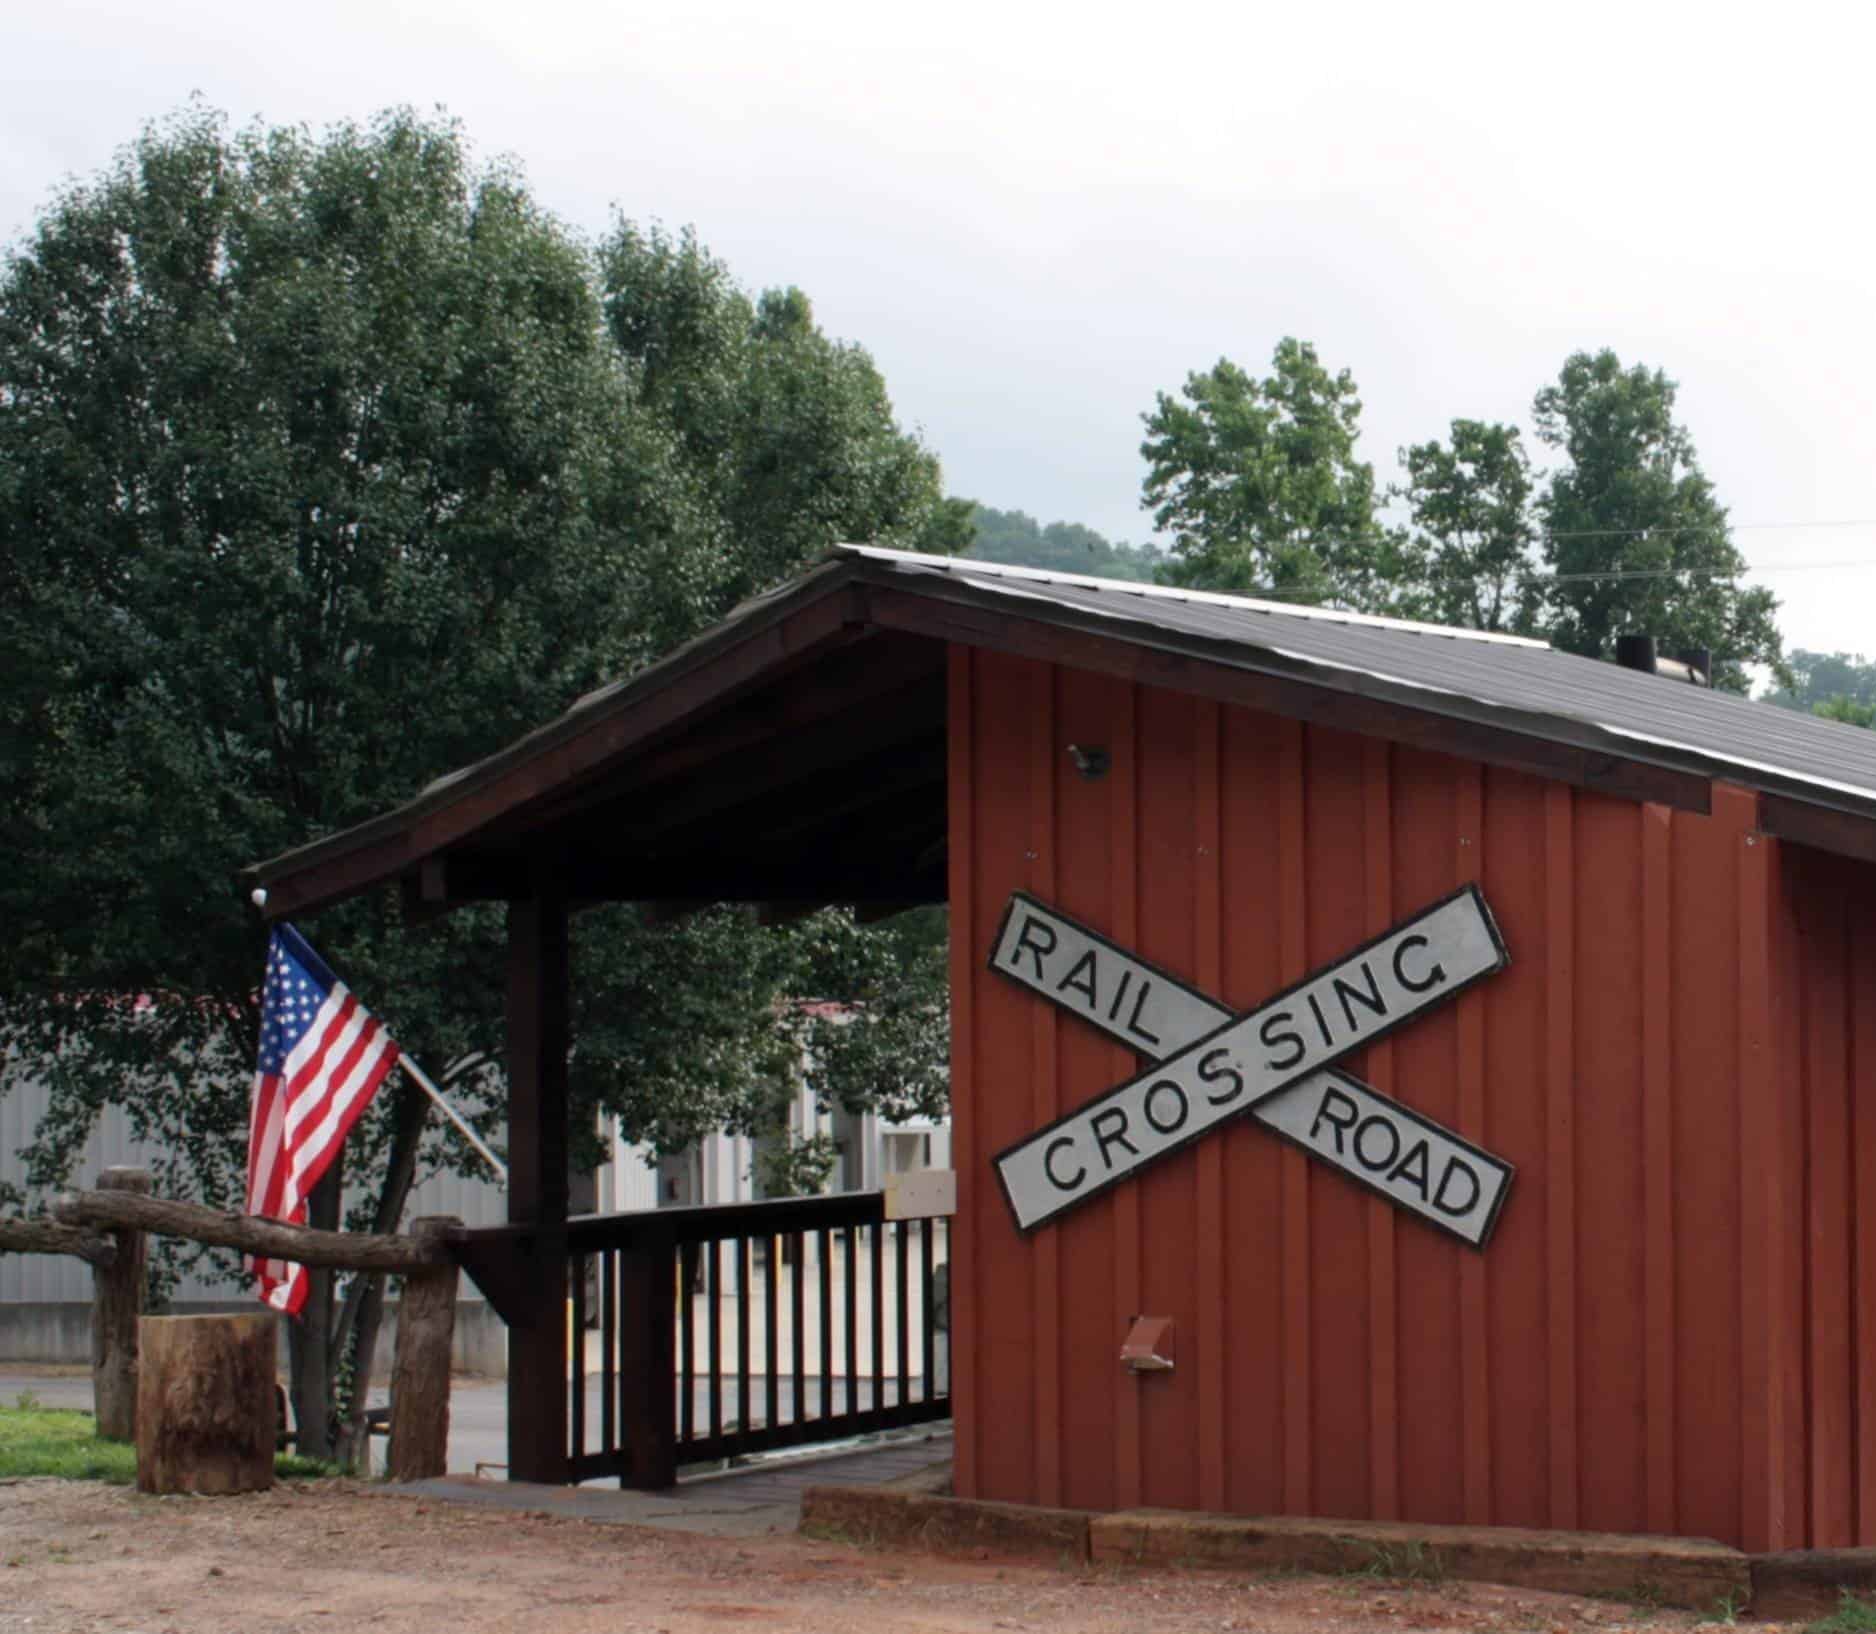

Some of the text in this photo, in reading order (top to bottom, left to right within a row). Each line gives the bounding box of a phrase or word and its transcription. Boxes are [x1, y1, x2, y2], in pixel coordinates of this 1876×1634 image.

[1010, 914, 1160, 1046] RAIL
[1042, 934, 1448, 1192] CROSSING
[1308, 1085, 1481, 1219] ROAD
